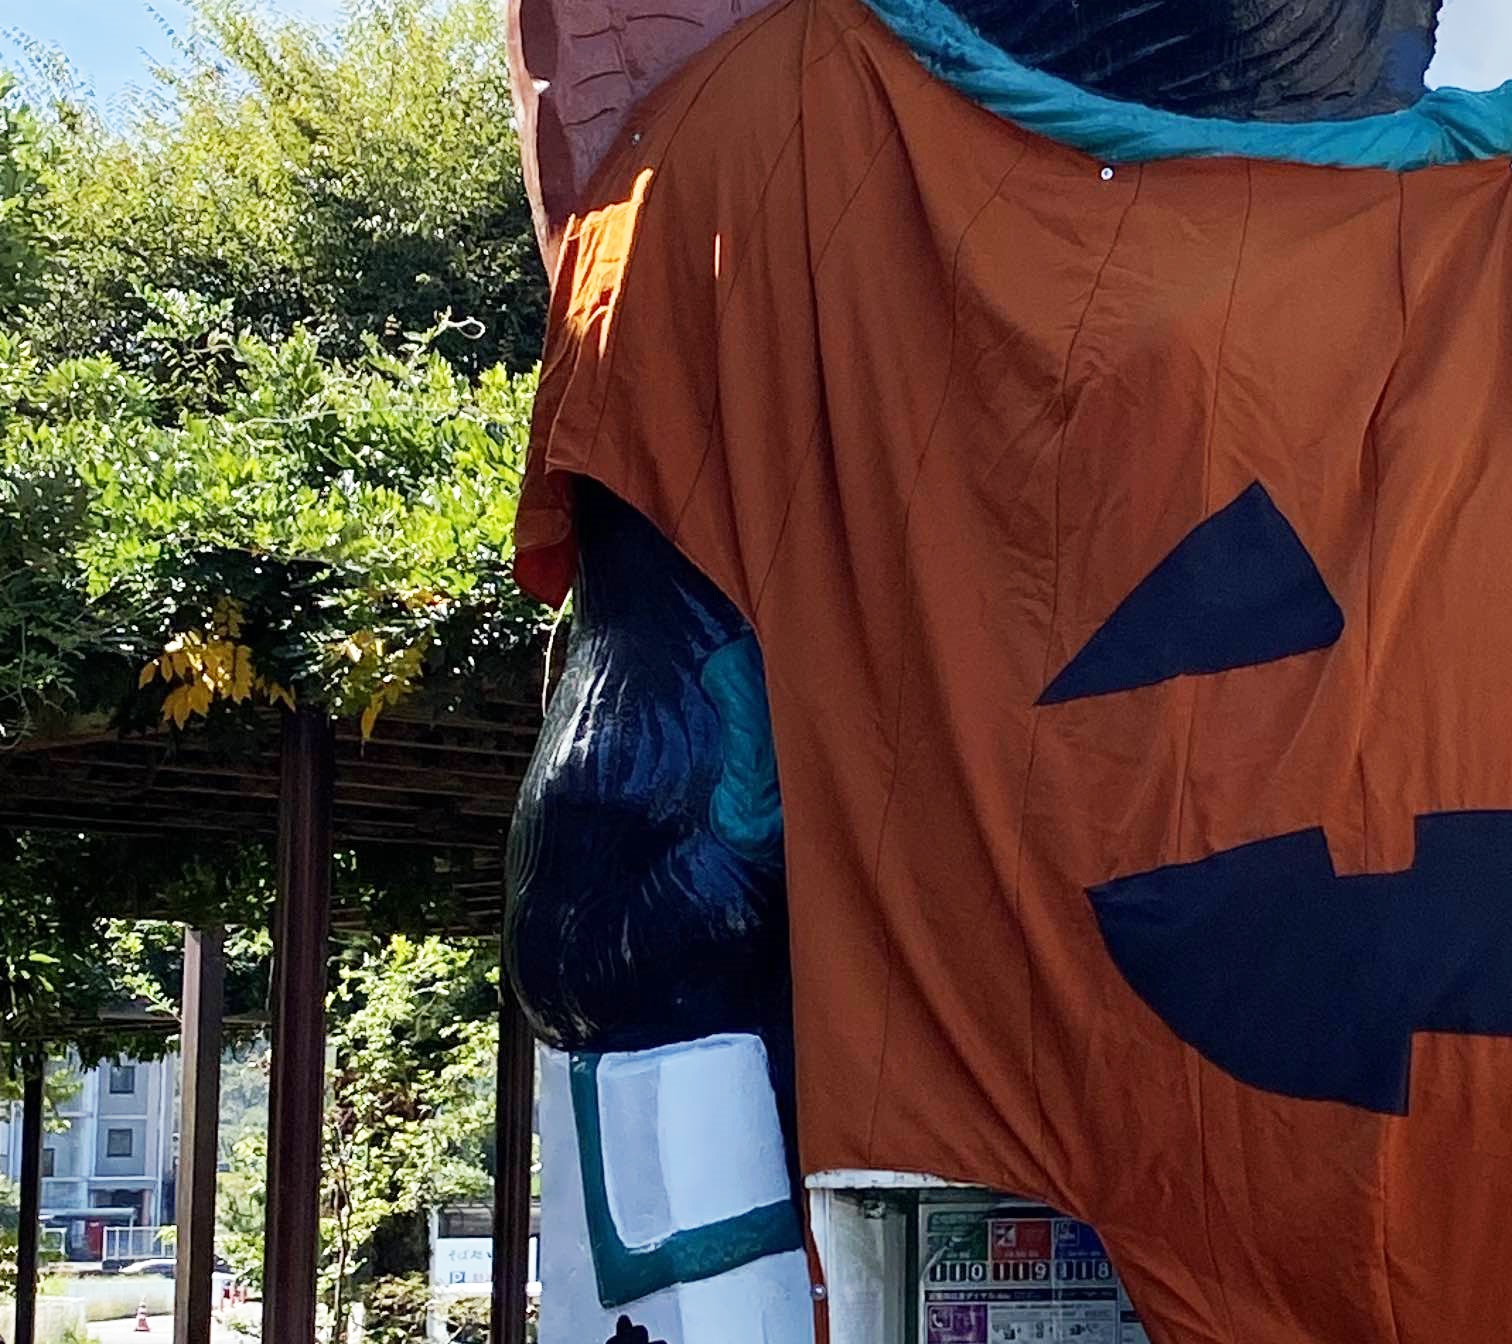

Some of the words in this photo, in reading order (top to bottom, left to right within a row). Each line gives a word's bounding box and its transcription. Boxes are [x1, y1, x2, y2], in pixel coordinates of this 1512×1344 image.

[933, 1263, 984, 1280] 110
[999, 1263, 1047, 1280] 119
[1060, 1263, 1109, 1280] 118
